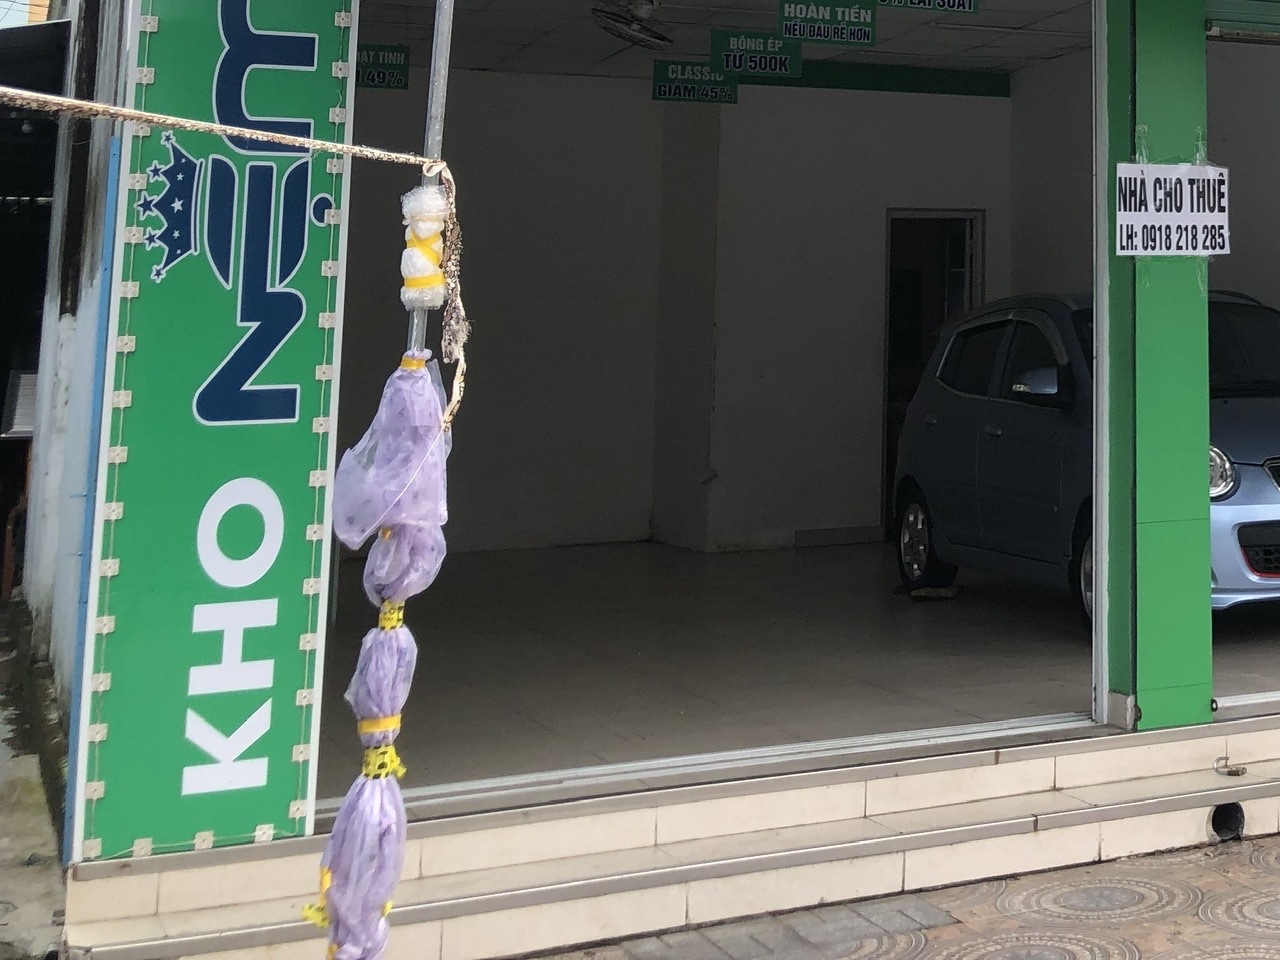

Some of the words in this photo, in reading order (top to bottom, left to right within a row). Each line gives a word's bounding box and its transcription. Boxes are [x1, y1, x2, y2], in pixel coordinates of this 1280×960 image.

[784, 2, 830, 20] HOÀN
[748, 53, 790, 73] 500K
[657, 80, 697, 99] GIẢM
[700, 84, 733, 101] 45%
[1118, 169, 1148, 213] NHÀ
[1153, 177, 1183, 213] CHO
[1187, 172, 1226, 213] THUÊ
[1119, 224, 1138, 251] LH:
[1141, 224, 1172, 251] 0918
[1175, 224, 1198, 251] 218
[1202, 224, 1226, 251] 285
[180, 477, 284, 797] KHO
